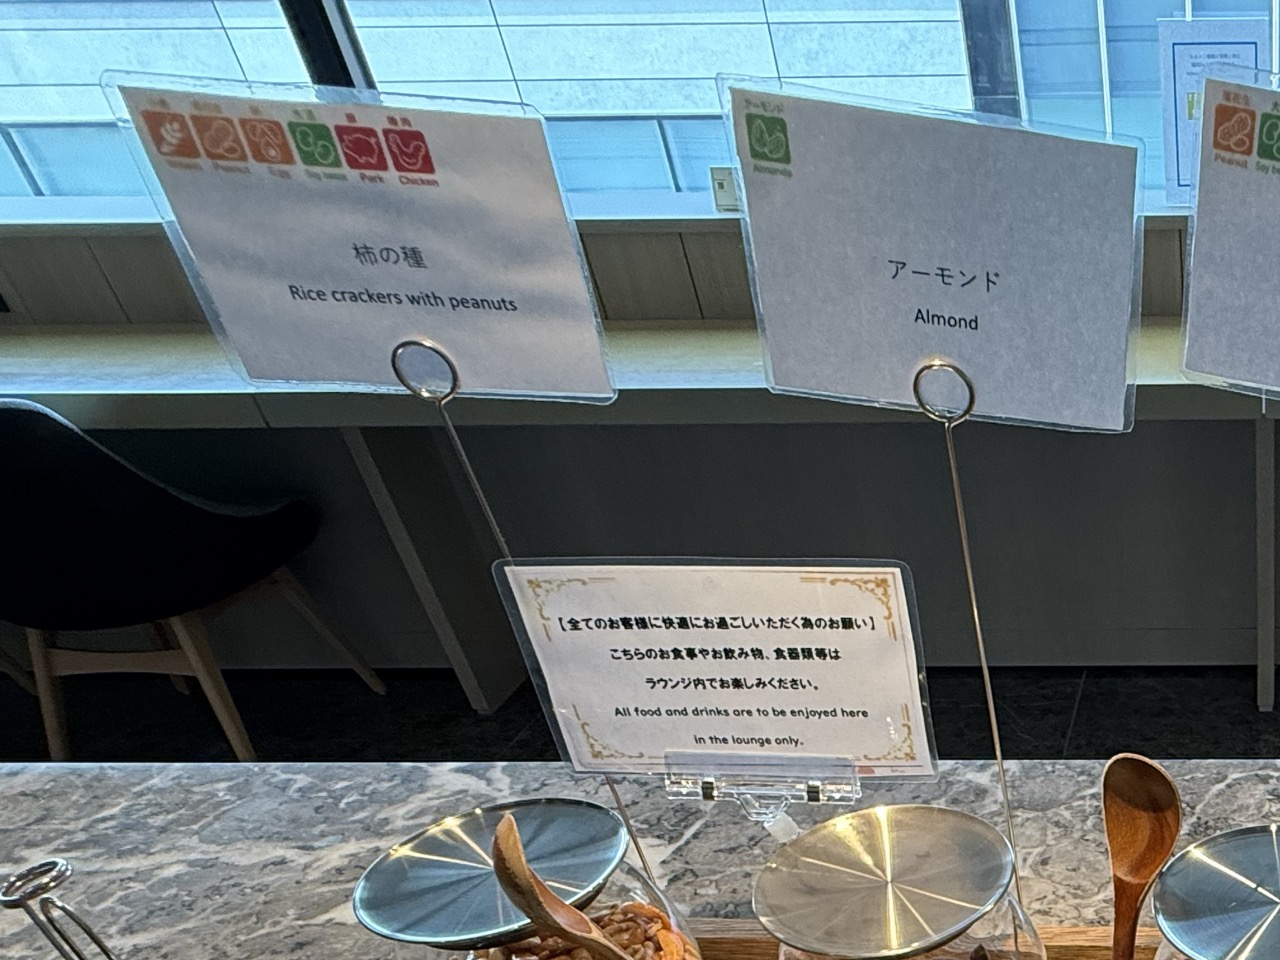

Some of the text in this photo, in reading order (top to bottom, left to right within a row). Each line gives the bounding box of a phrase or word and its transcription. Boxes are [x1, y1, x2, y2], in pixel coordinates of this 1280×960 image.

[1214, 153, 1248, 169] Peanut
[1255, 160, 1271, 175] Soy
[399, 175, 440, 188] Chicken
[351, 242, 428, 269] 柿の種
[887, 259, 1000, 293] アーモンド
[288, 284, 519, 313] Rice crackers with peanuts
[914, 308, 979, 331] Almond
[645, 677, 820, 691] ラウンジ内でお楽しみください。
[614, 706, 869, 719] All food and drinks are to be enjoyed here
[693, 734, 804, 748] in the lounge only.
